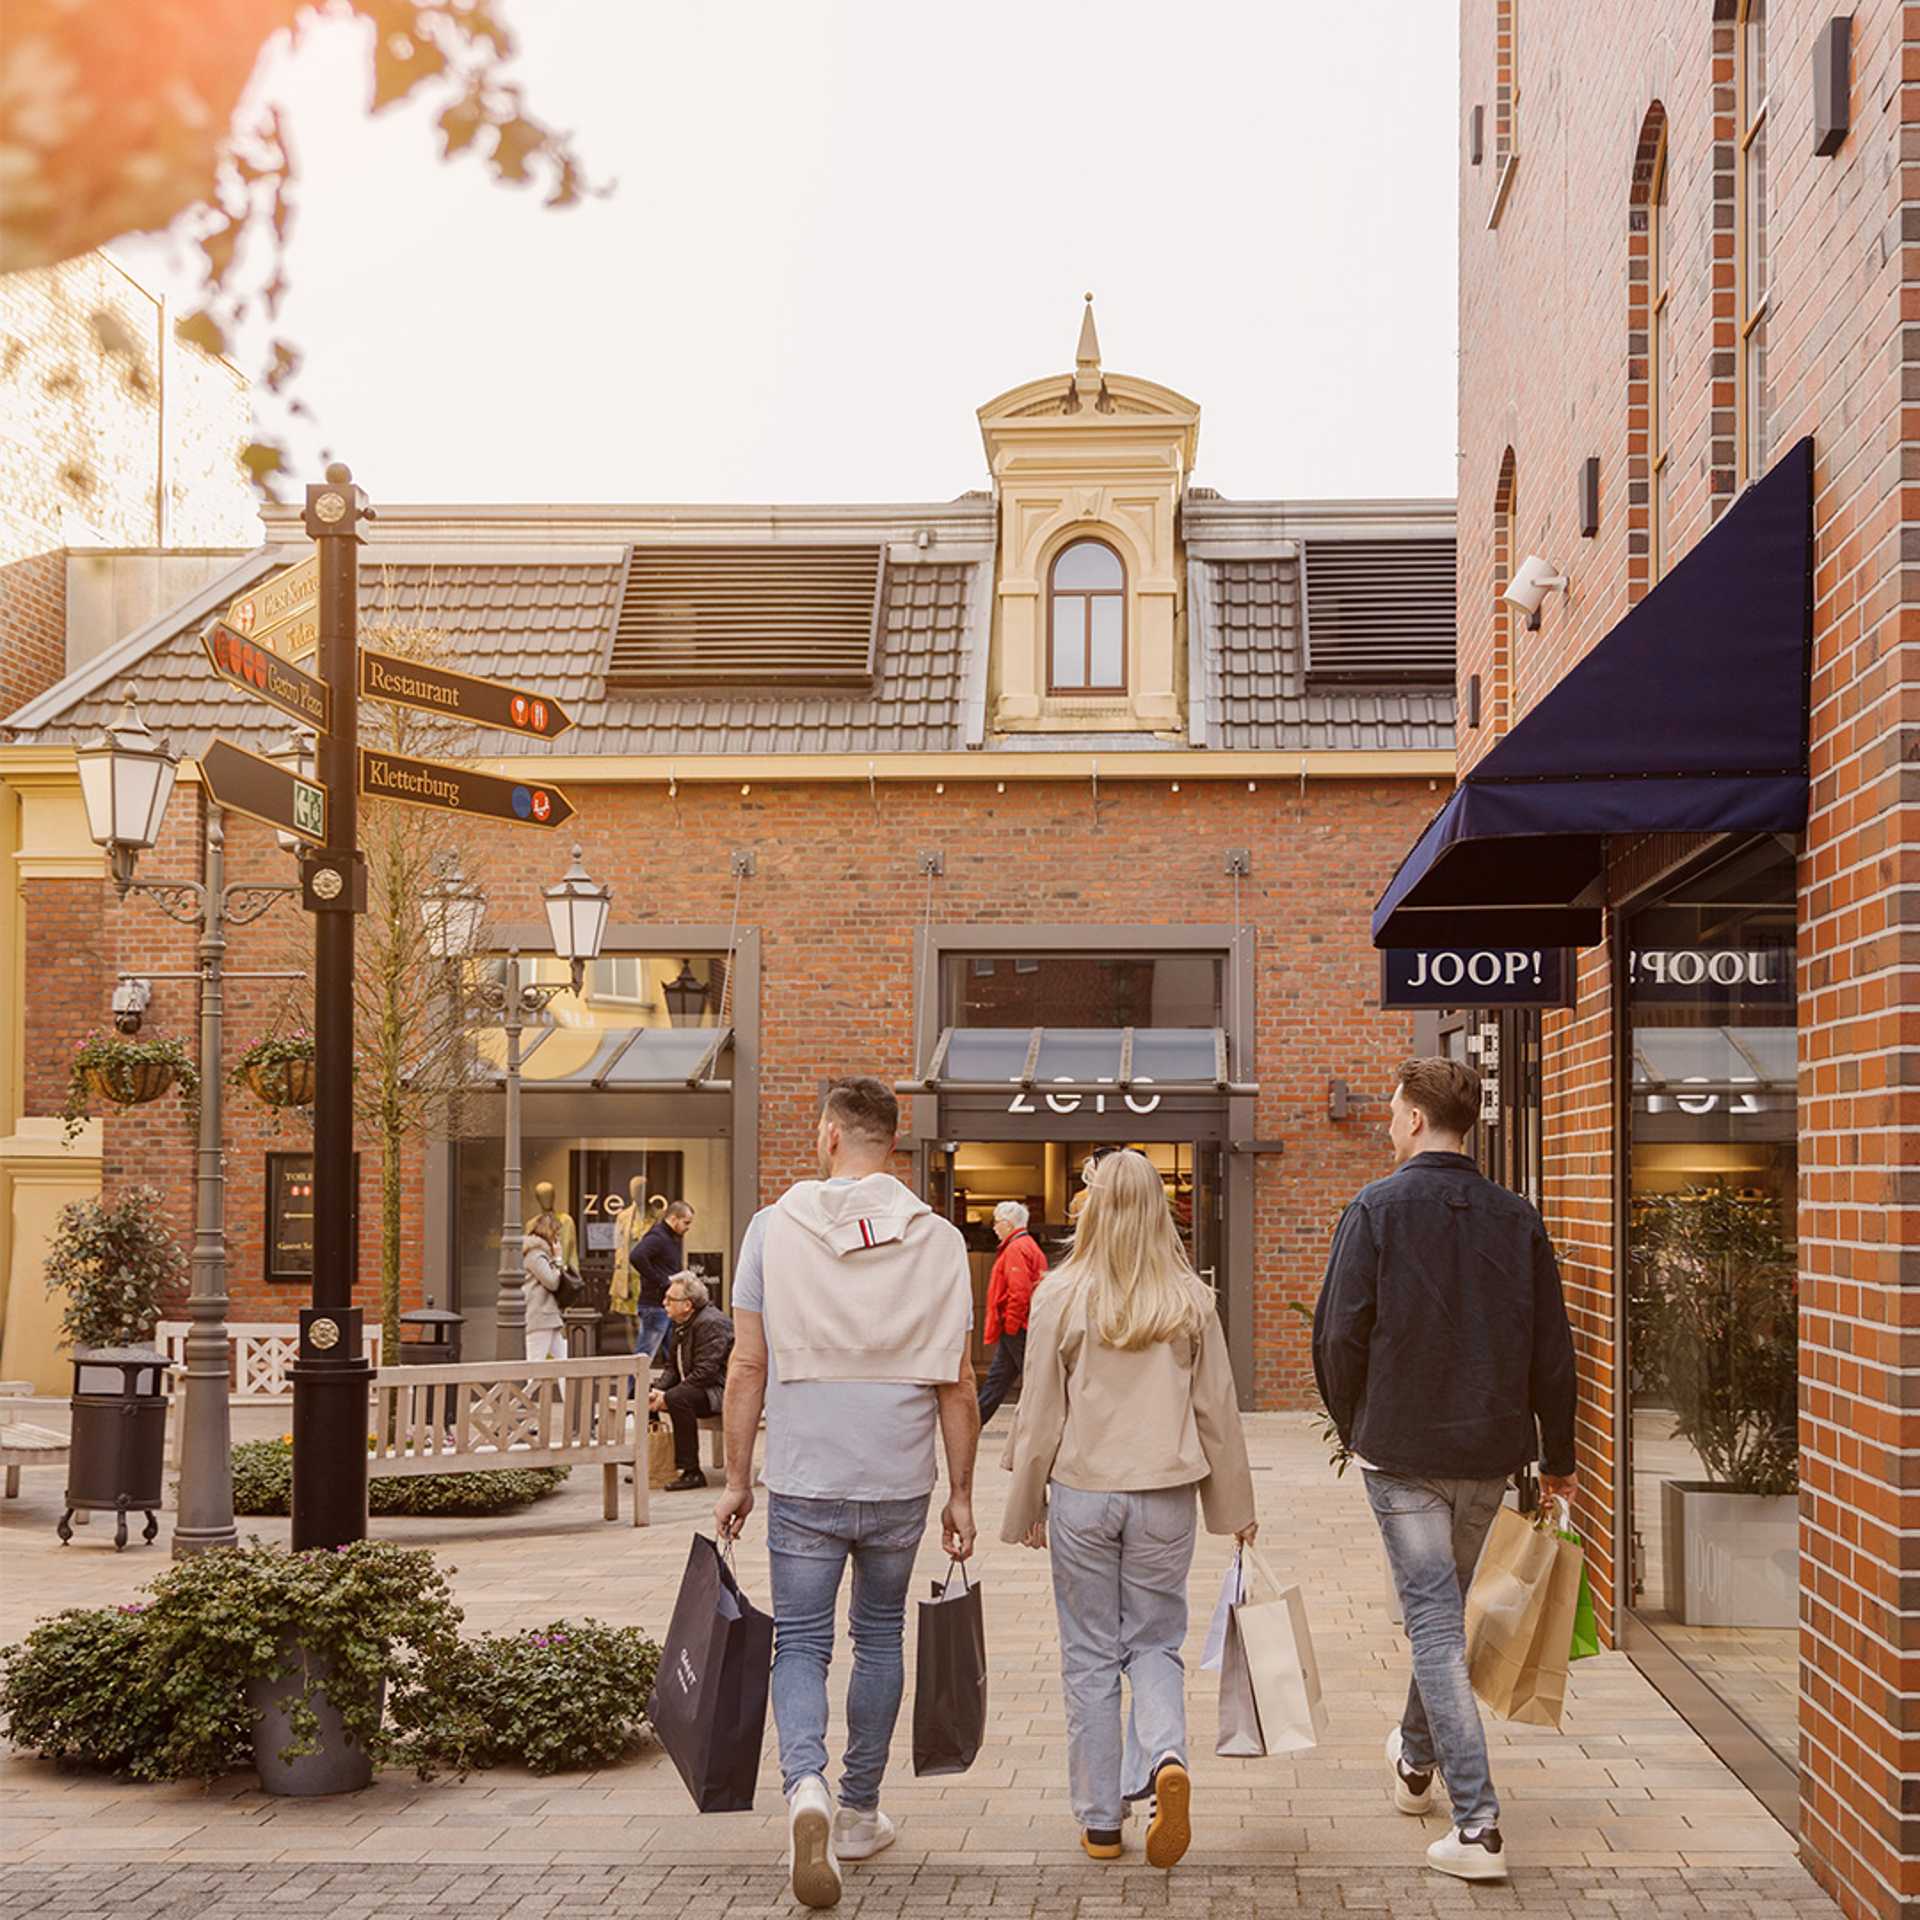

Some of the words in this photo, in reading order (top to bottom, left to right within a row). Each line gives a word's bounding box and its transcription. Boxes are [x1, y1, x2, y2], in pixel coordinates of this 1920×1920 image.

[268, 663, 300, 705] Gastro
[369, 661, 460, 707] Restaurant
[369, 760, 460, 807] Kletterburg
[1408, 950, 1542, 987] JOOP!
[1008, 1076, 1161, 1114] zero
